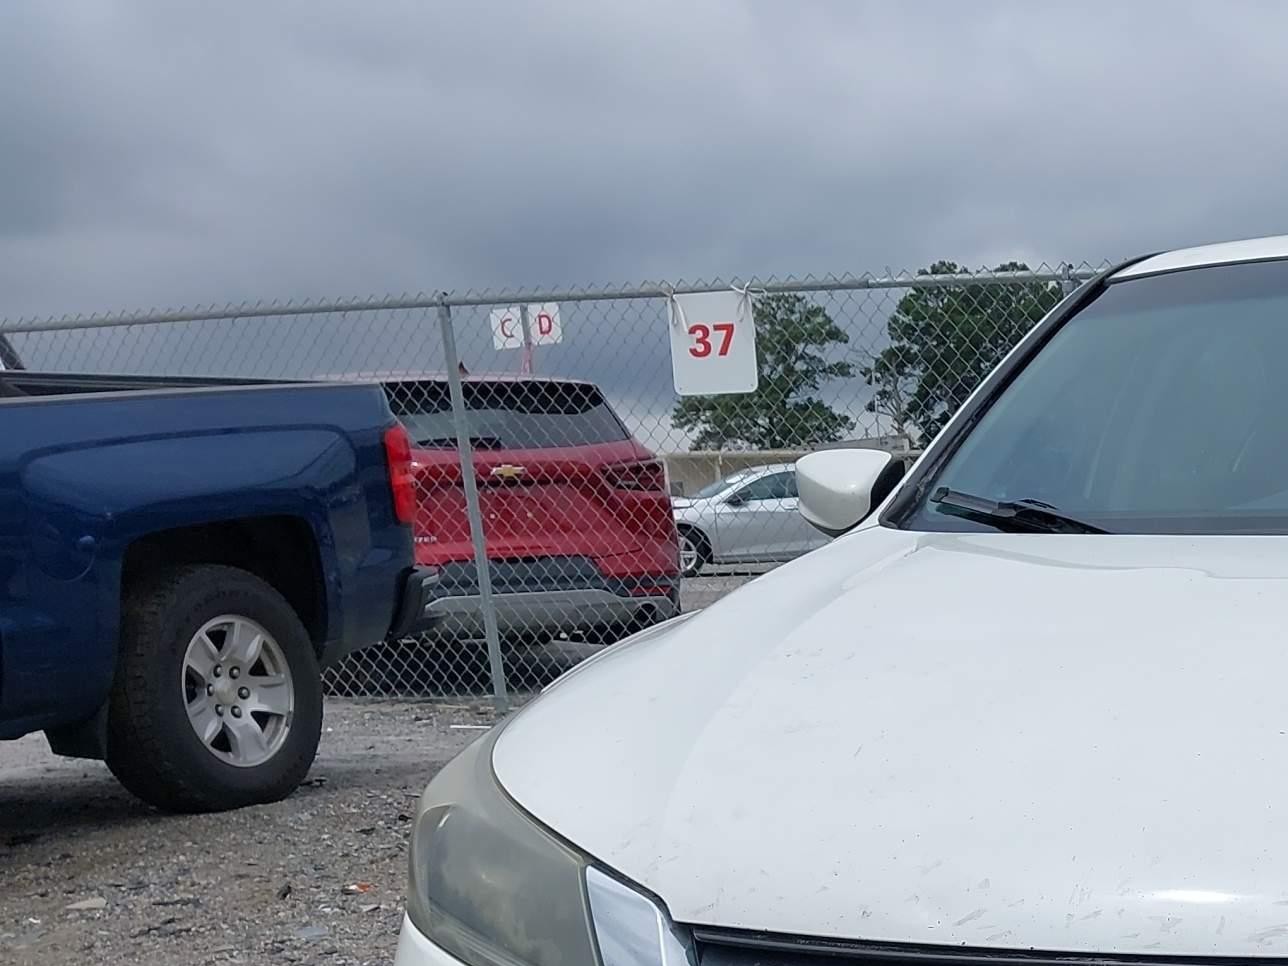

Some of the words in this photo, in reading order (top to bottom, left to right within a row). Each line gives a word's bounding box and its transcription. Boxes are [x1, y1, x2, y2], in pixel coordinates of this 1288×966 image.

[500, 318, 515, 339] C
[537, 314, 553, 335] D
[687, 323, 735, 358] 37
